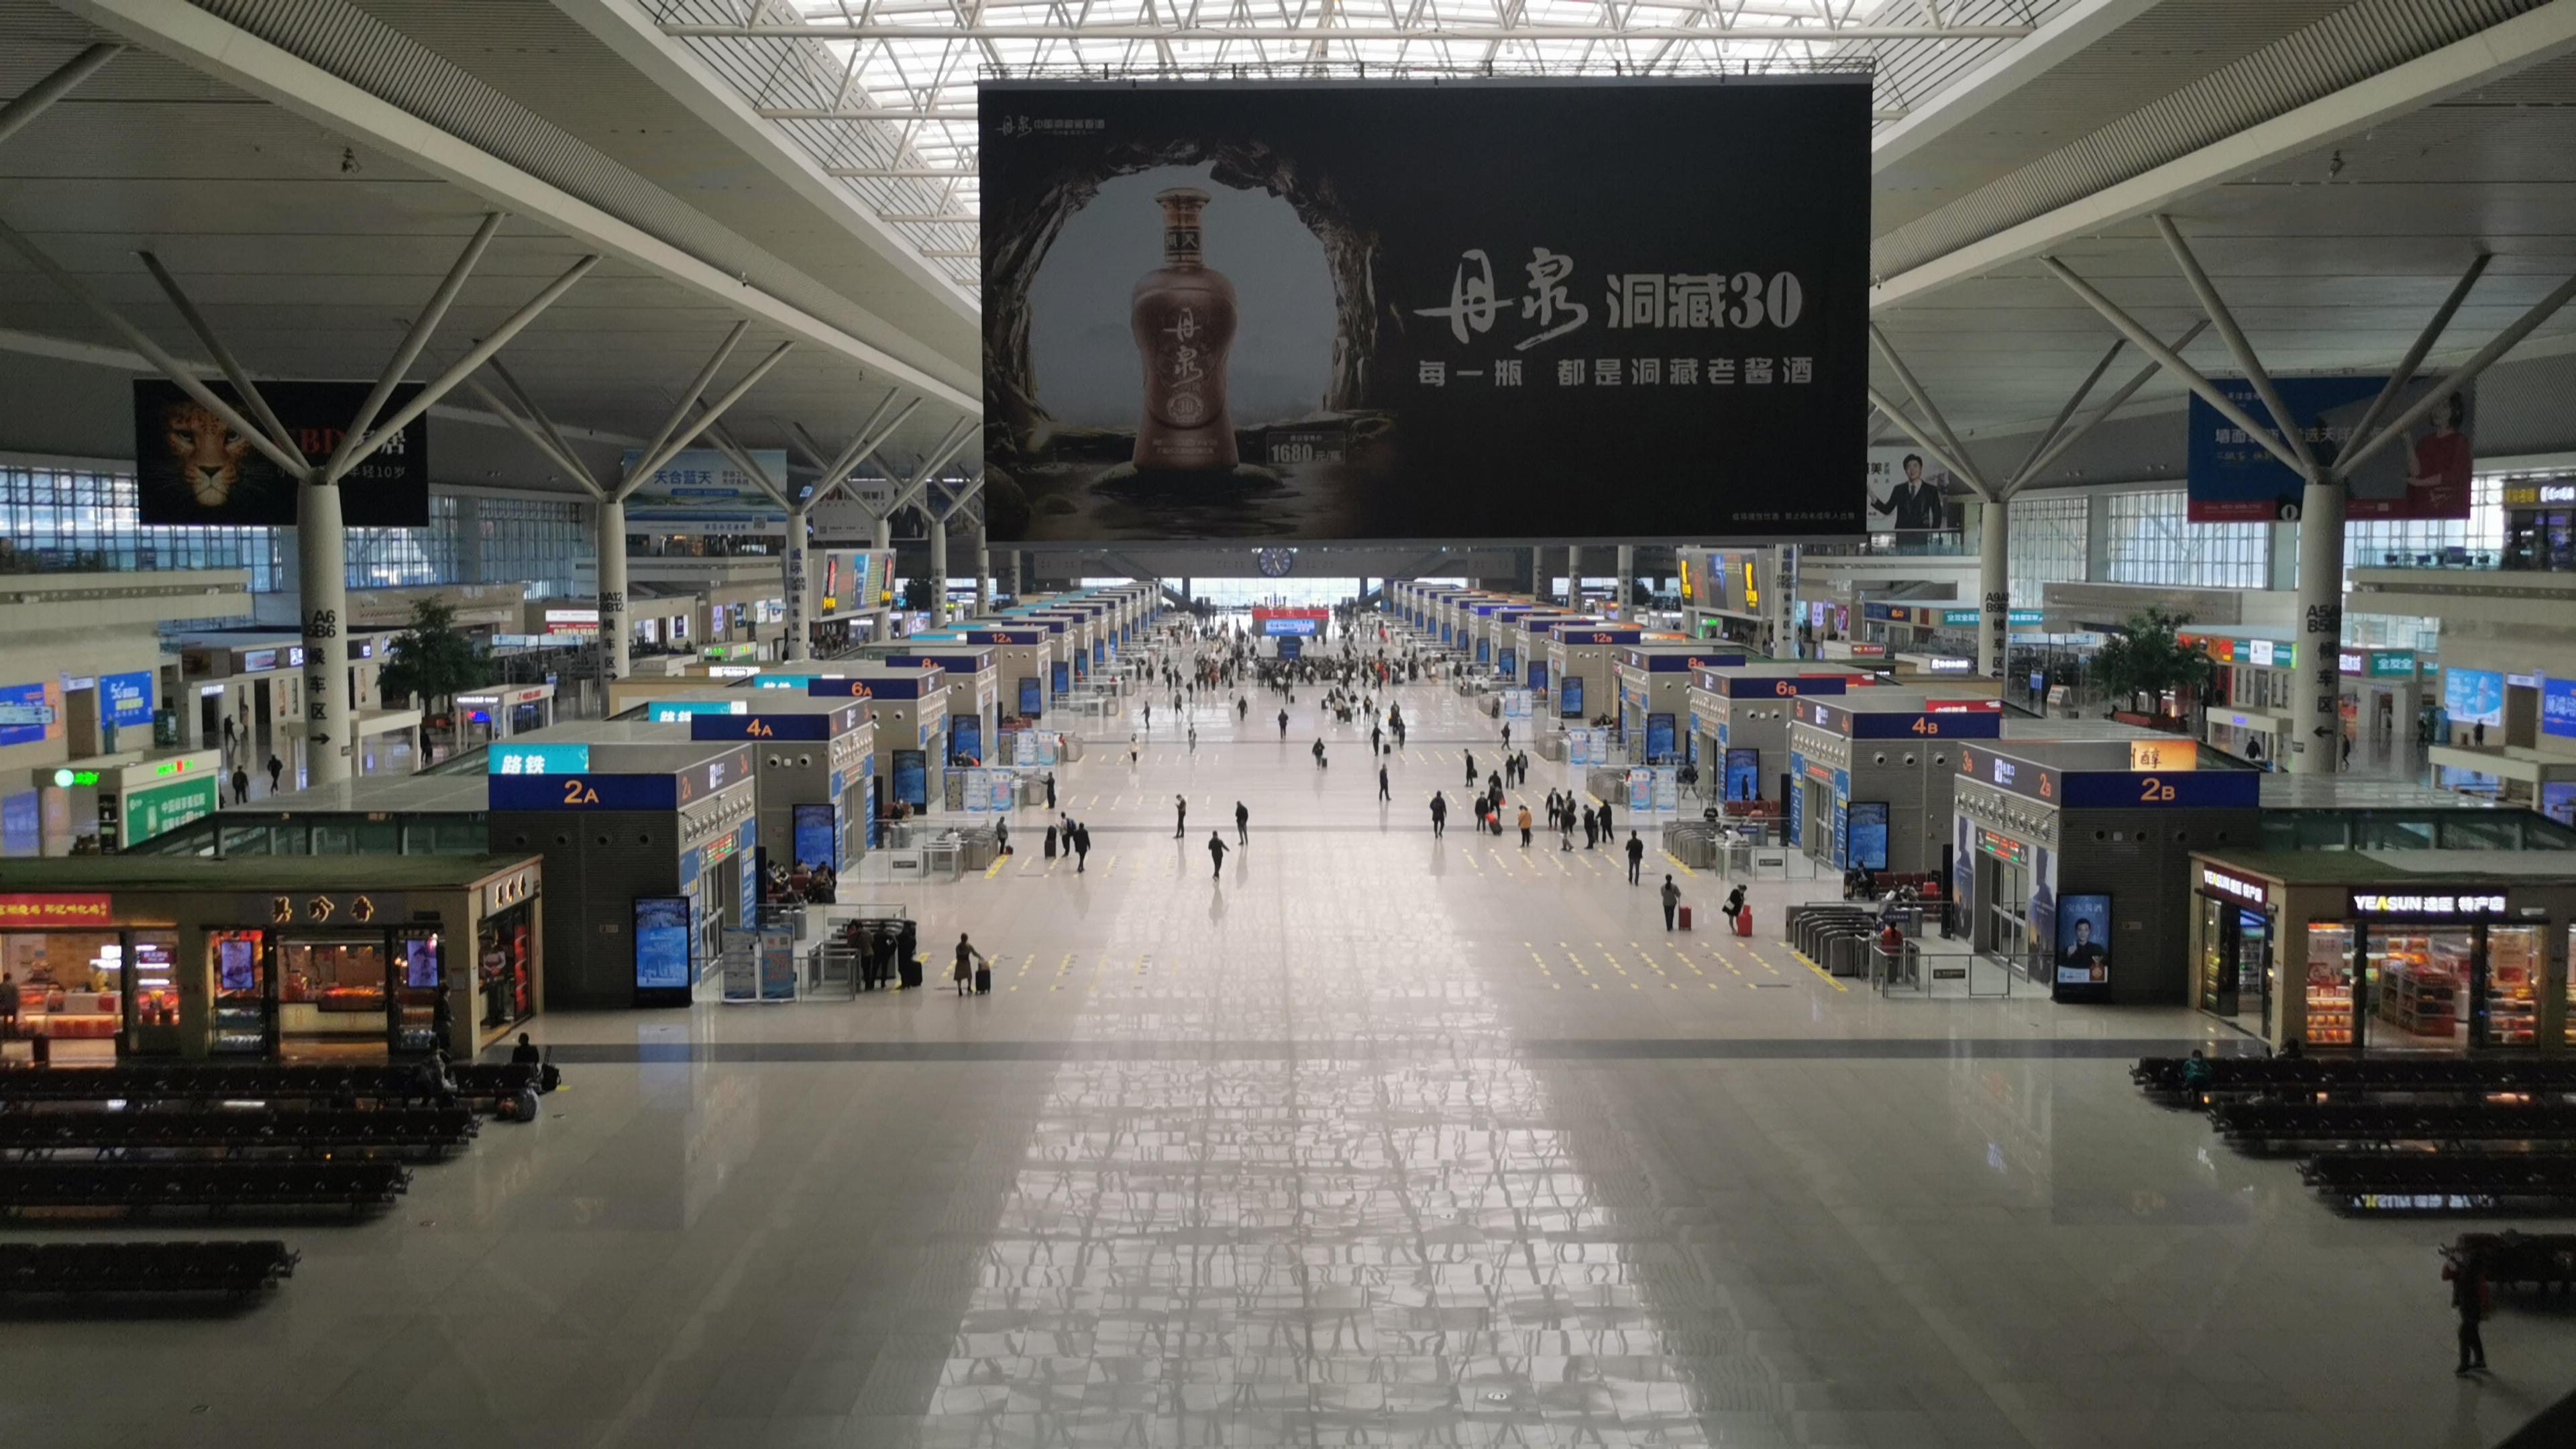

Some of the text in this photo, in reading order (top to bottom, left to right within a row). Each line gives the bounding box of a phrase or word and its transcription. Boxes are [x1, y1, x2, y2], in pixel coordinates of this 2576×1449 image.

[1413, 247, 1803, 352] 丹泉 洞藏30
[1419, 356, 1813, 386] 每一瓶 都是洞藏老酱酒
[654, 470, 712, 484] 天合蓝天
[991, 633, 1013, 644] 12A
[309, 647, 327, 720] 候车区
[851, 682, 873, 696] 6A
[1776, 681, 1797, 696] 6B
[747, 718, 773, 737] 4A
[1912, 716, 1938, 735] 4B
[564, 780, 600, 804] 2A
[2141, 777, 2176, 801] 2B
[2353, 896, 2422, 911] YEASUN
